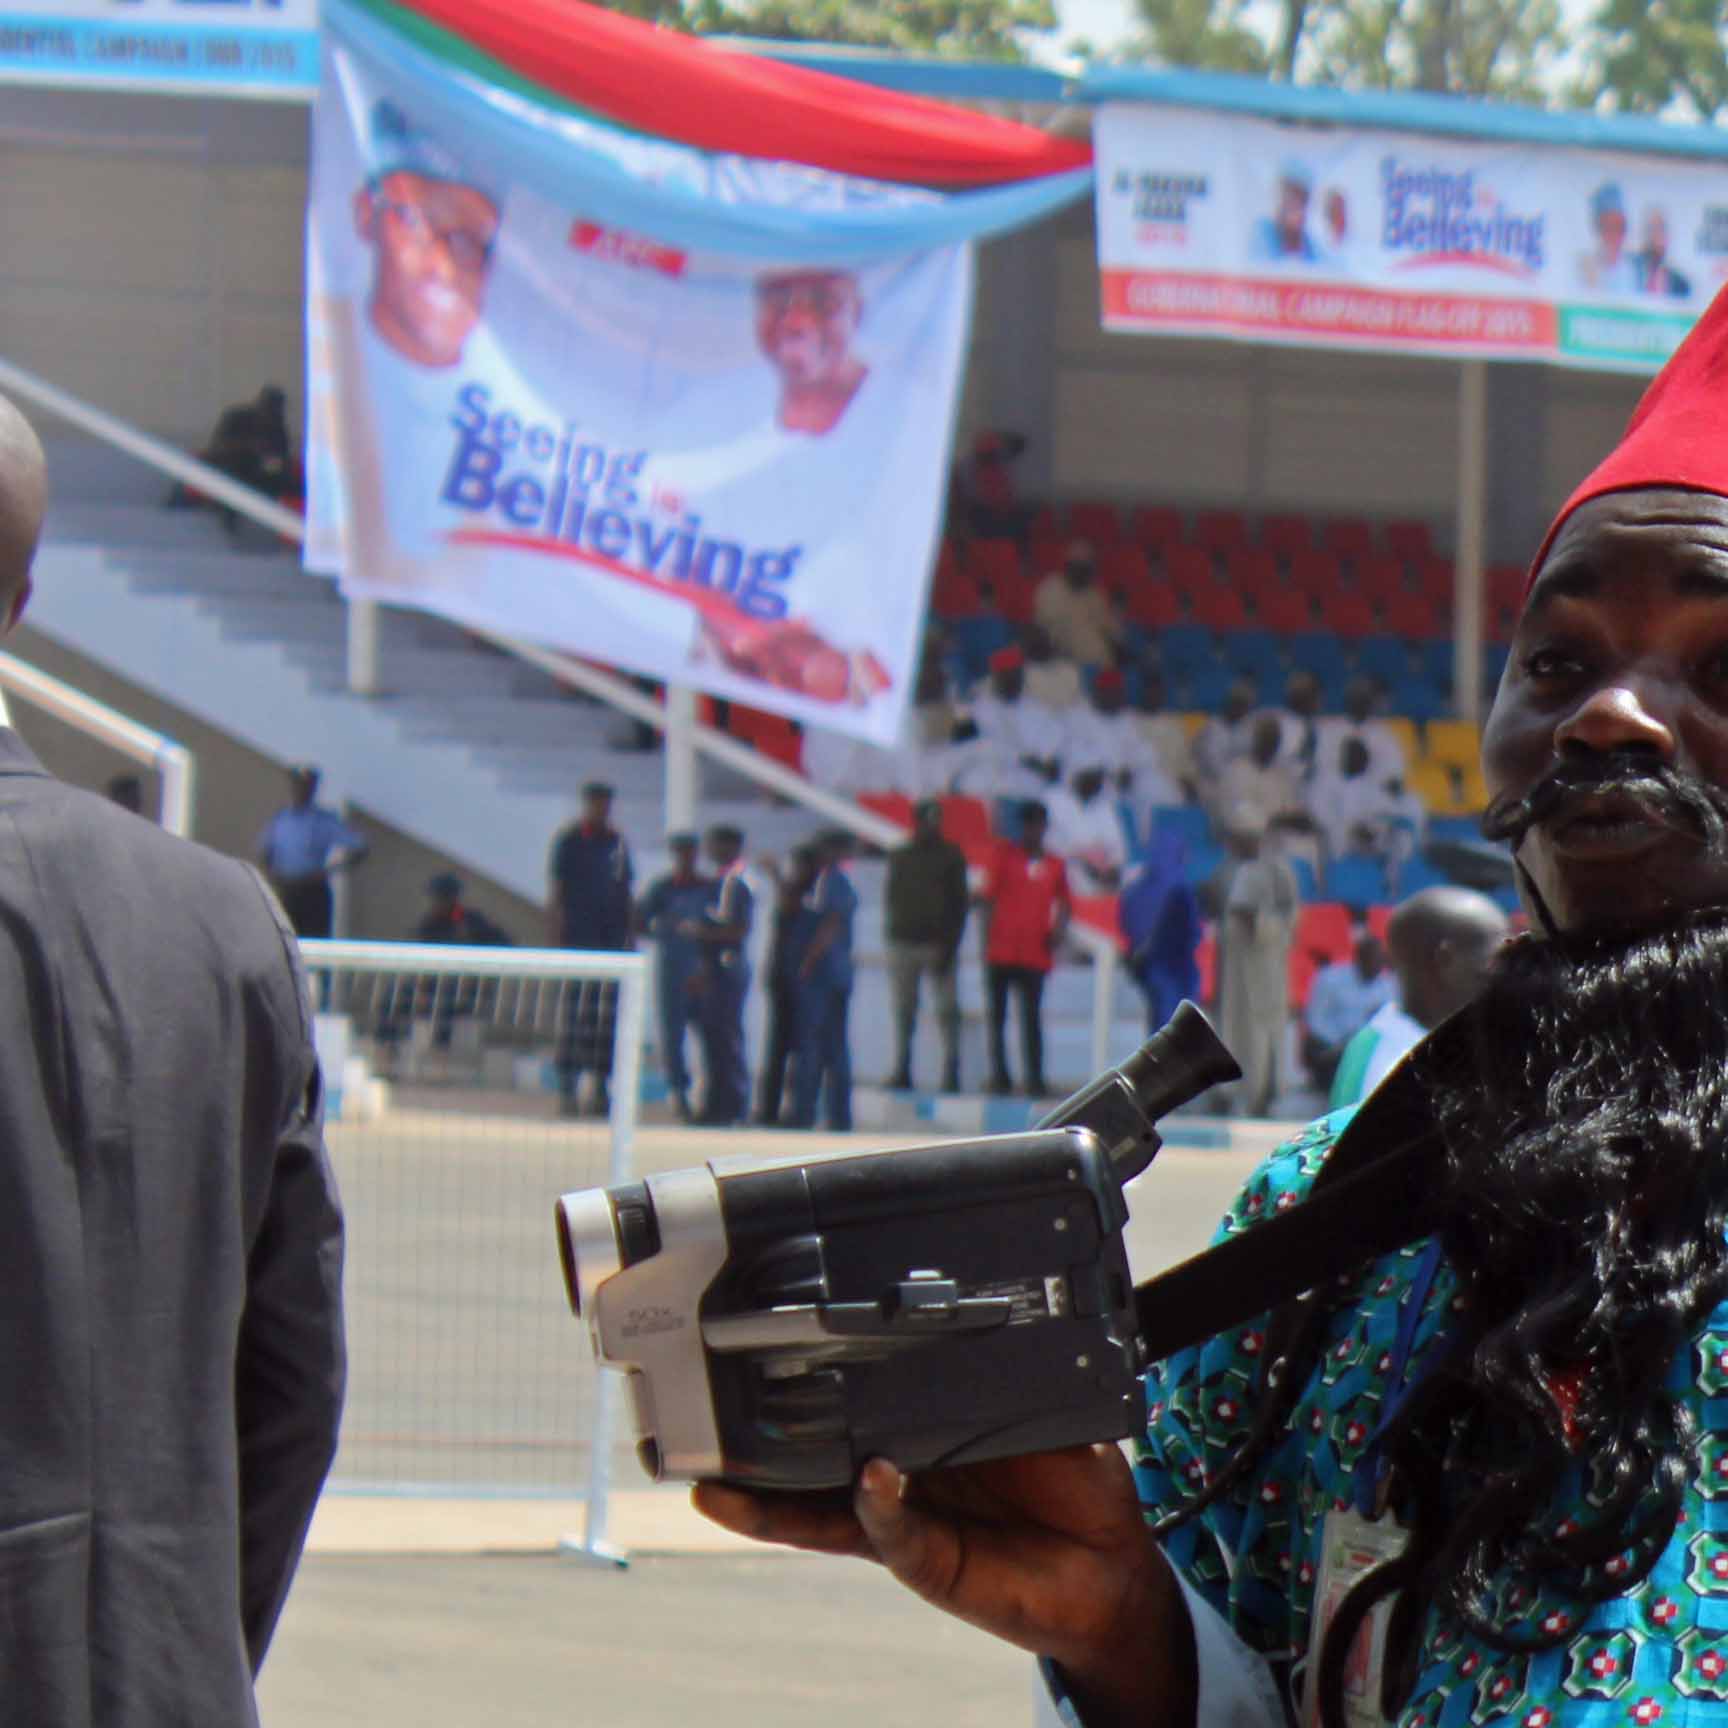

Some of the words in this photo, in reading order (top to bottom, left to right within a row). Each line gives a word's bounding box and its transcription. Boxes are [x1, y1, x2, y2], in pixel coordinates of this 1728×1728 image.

[1383, 196, 1545, 270] Believing
[448, 382, 648, 504] Seeing
[438, 426, 804, 622] Believing
